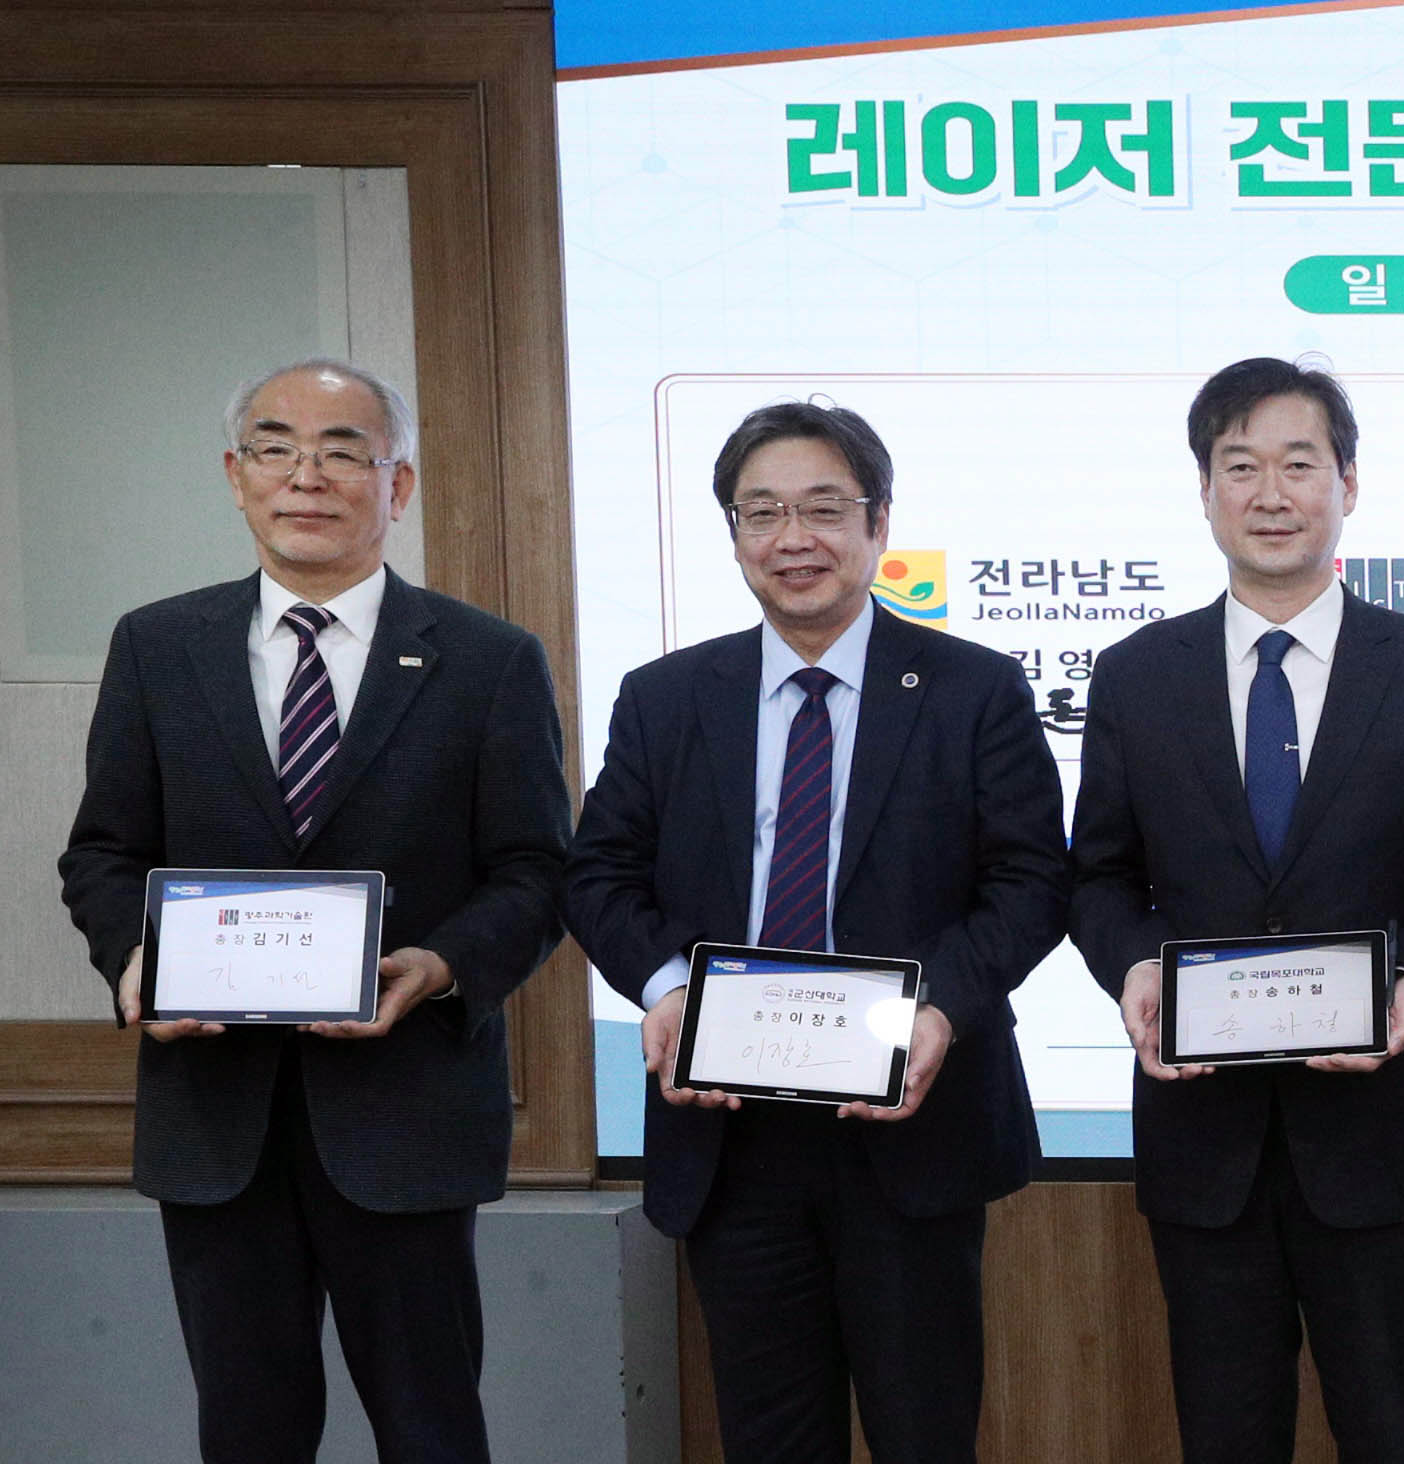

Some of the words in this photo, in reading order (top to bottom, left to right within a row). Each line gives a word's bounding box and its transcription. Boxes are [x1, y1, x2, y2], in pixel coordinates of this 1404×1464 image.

[786, 100, 1174, 197] 레이저
[968, 559, 1166, 597] 전라남도
[971, 602, 1166, 621] JeollaNamdo
